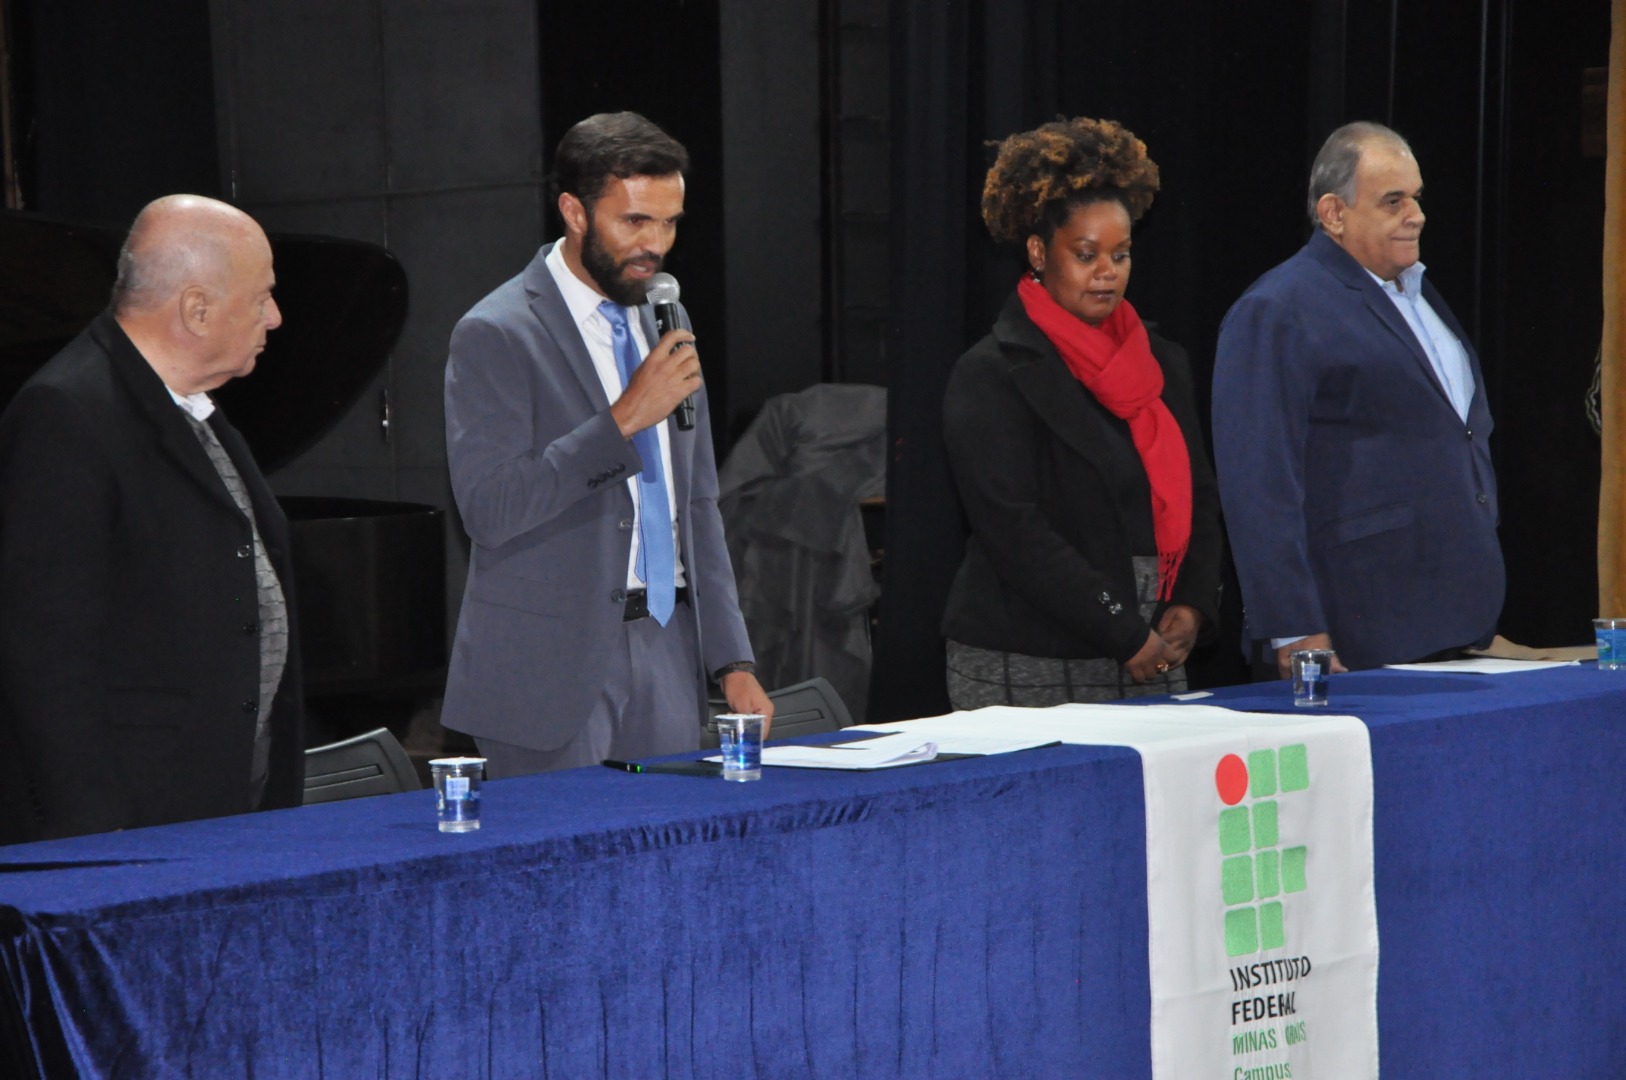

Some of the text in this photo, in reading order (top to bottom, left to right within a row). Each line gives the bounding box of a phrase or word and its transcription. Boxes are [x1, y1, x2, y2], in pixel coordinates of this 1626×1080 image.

[1229, 956, 1311, 992] INSTITUTO
[1233, 1027, 1277, 1056] MINAS
[1234, 1062, 1292, 1080] Campus
